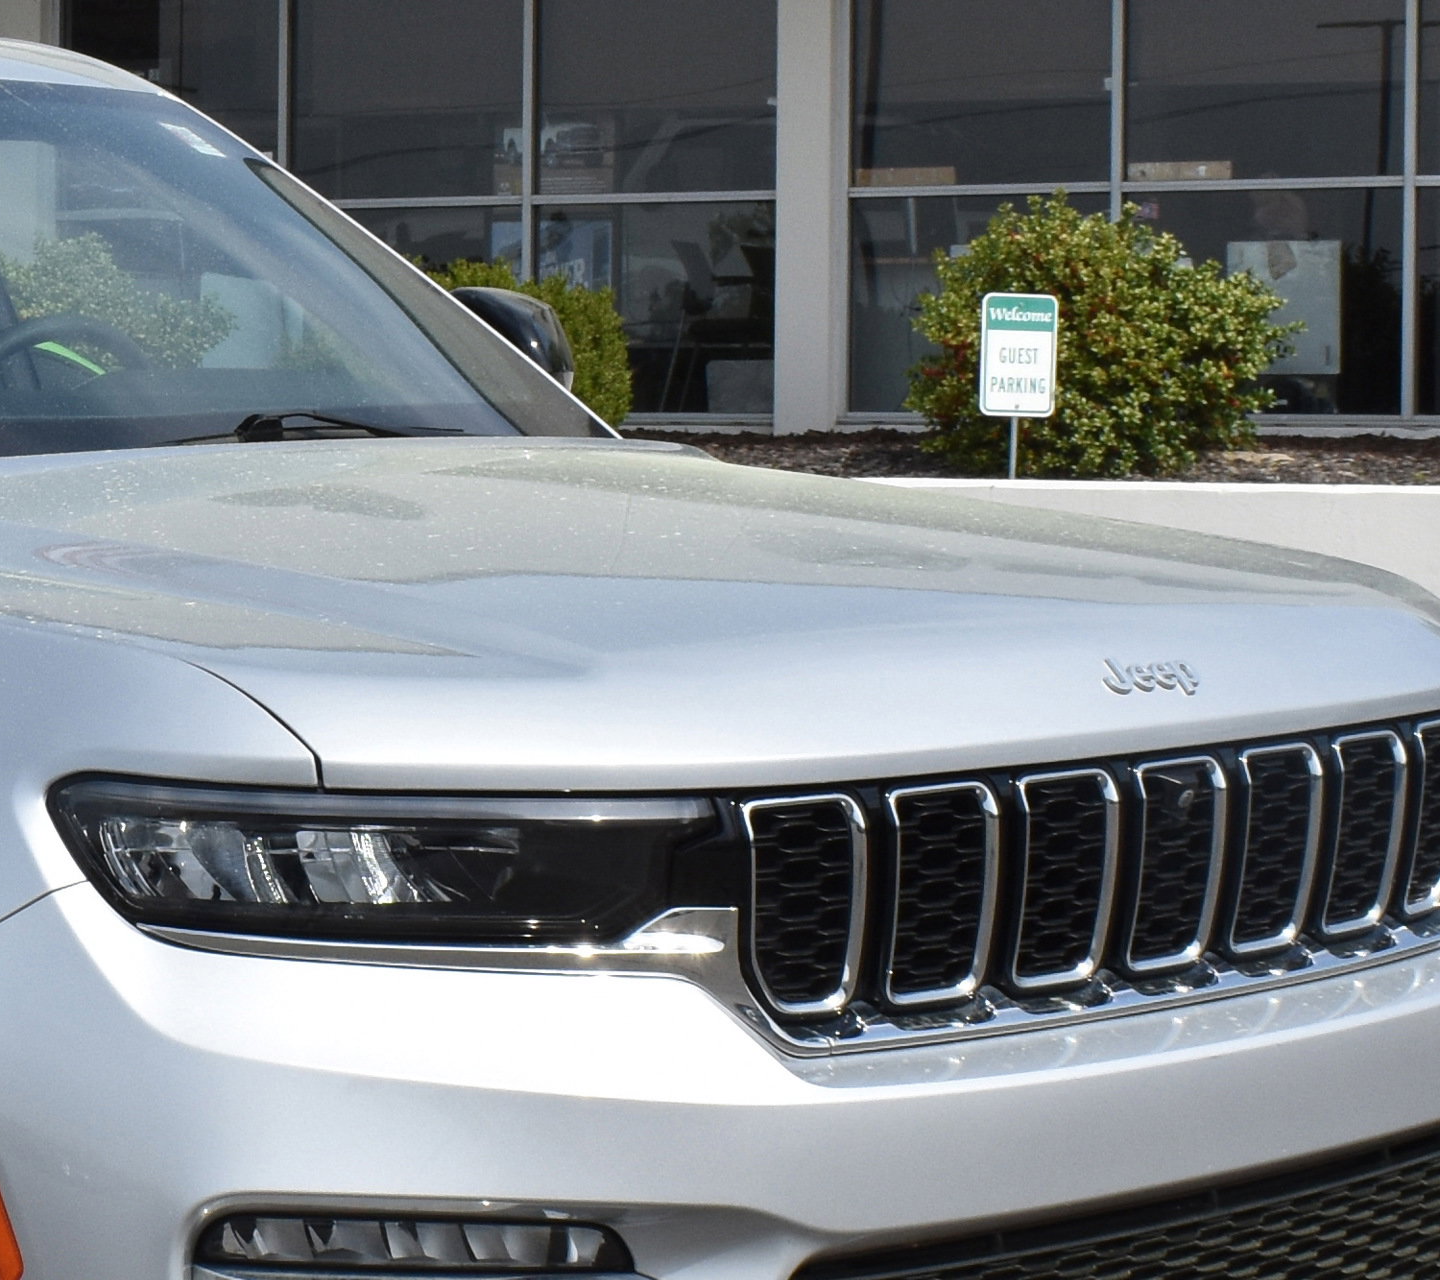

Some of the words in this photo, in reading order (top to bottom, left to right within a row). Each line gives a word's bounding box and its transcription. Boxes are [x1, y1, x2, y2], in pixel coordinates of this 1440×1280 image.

[989, 306, 1052, 323] Welcome
[998, 347, 1039, 365] GUEST
[989, 377, 1046, 394] PARKING
[1102, 657, 1199, 696] Jeep
